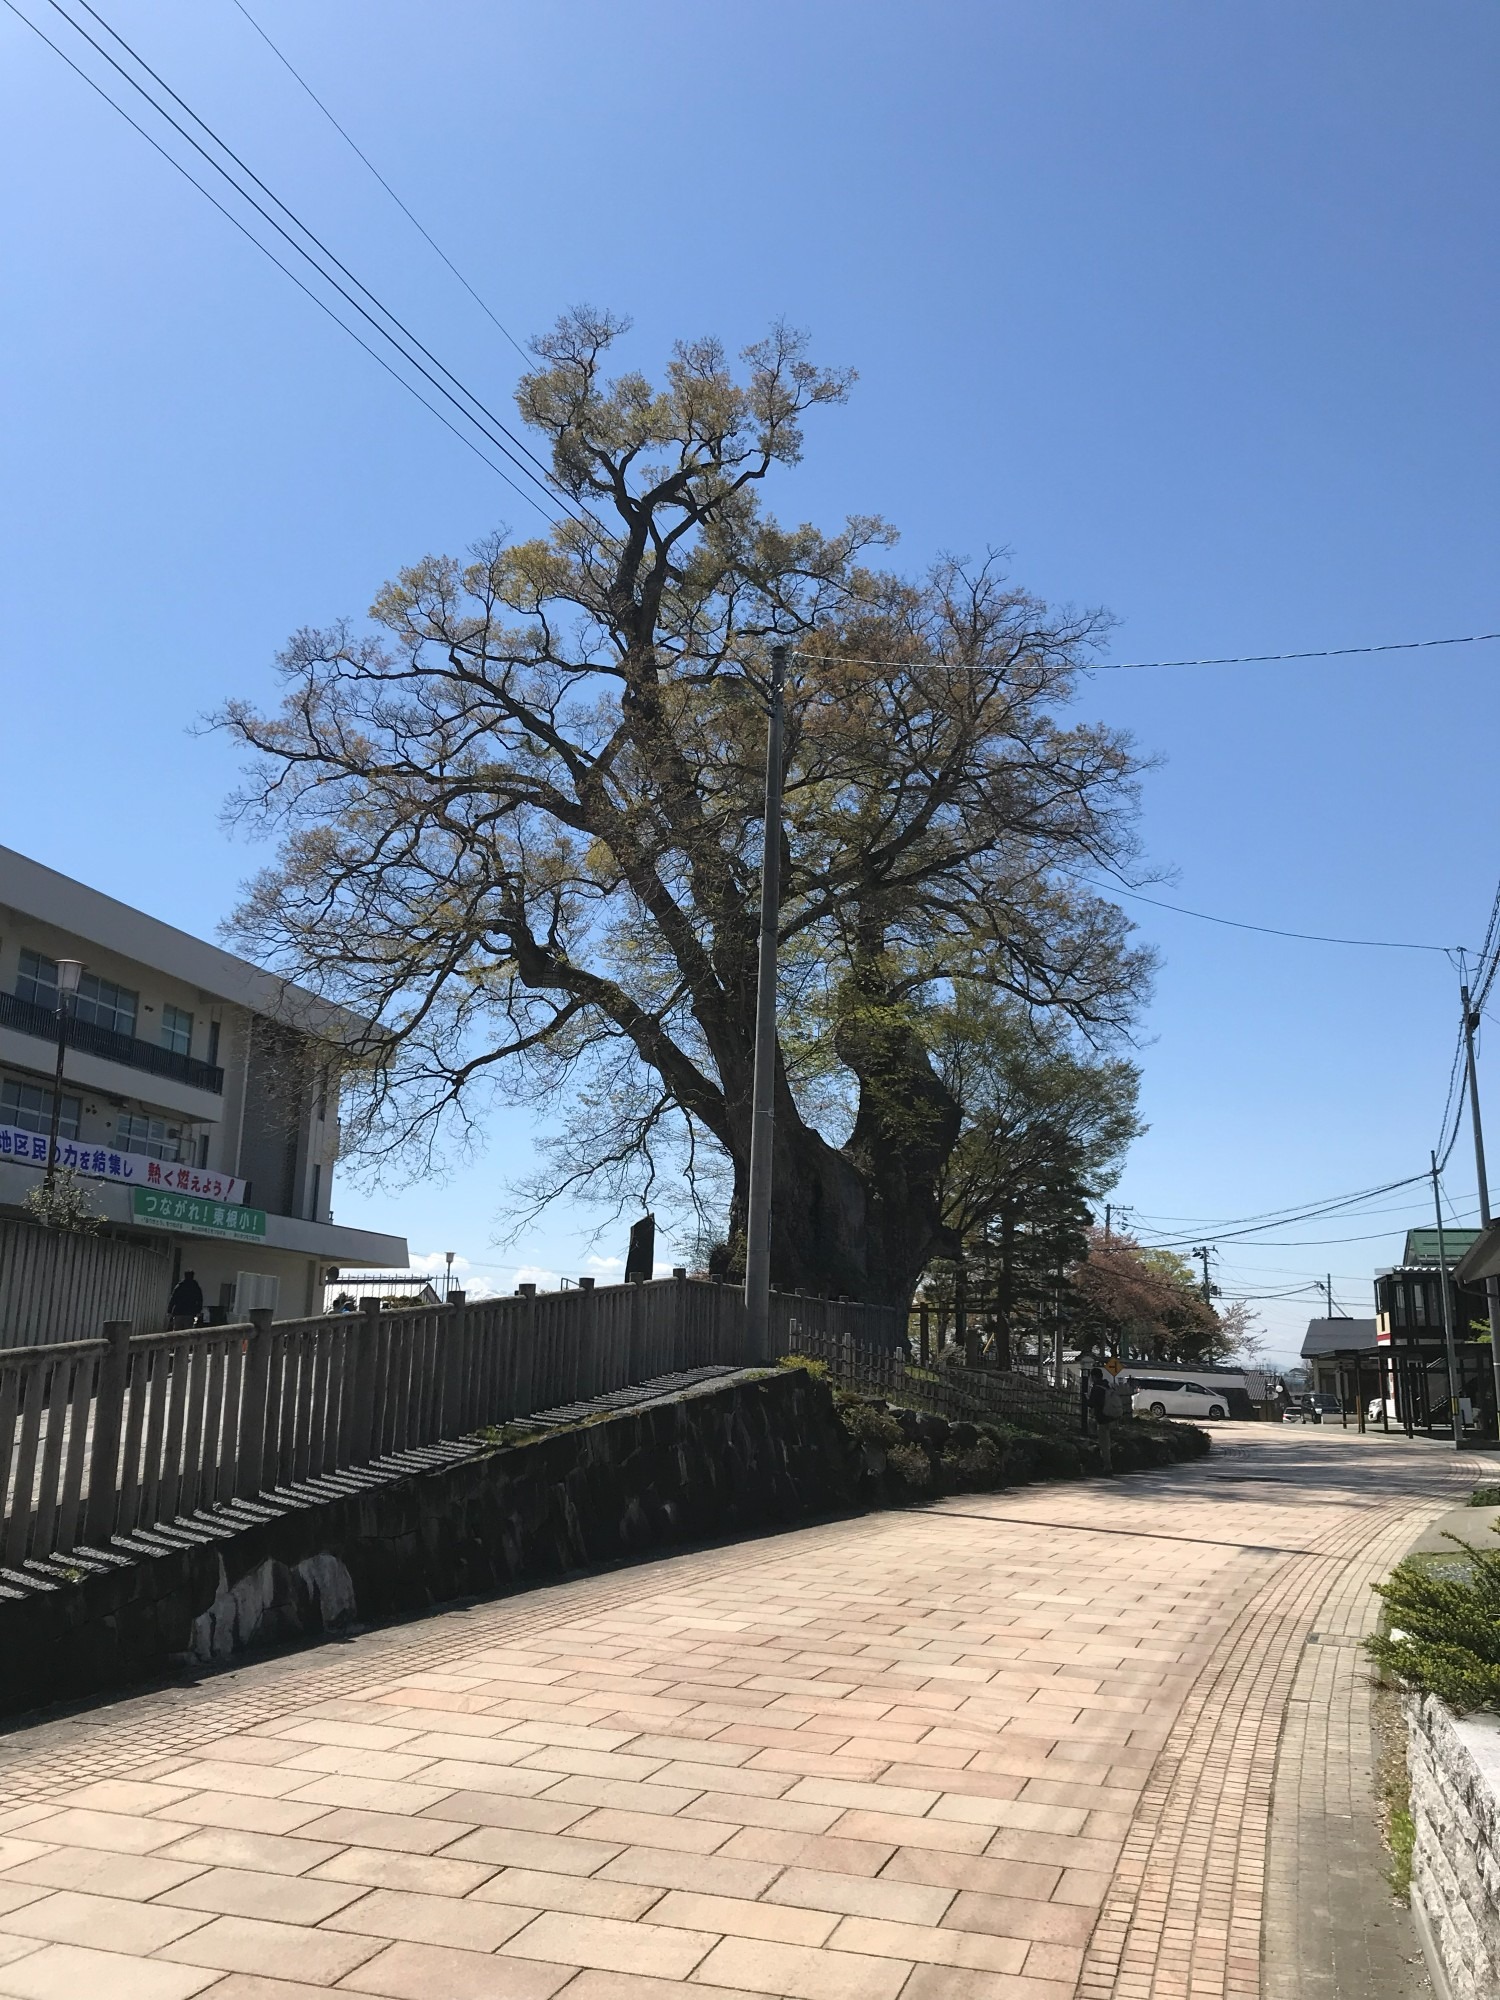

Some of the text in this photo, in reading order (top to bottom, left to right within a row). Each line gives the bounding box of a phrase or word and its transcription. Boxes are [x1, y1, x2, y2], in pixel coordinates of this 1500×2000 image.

[147, 1162, 235, 1202] 熱く燃えよう！
